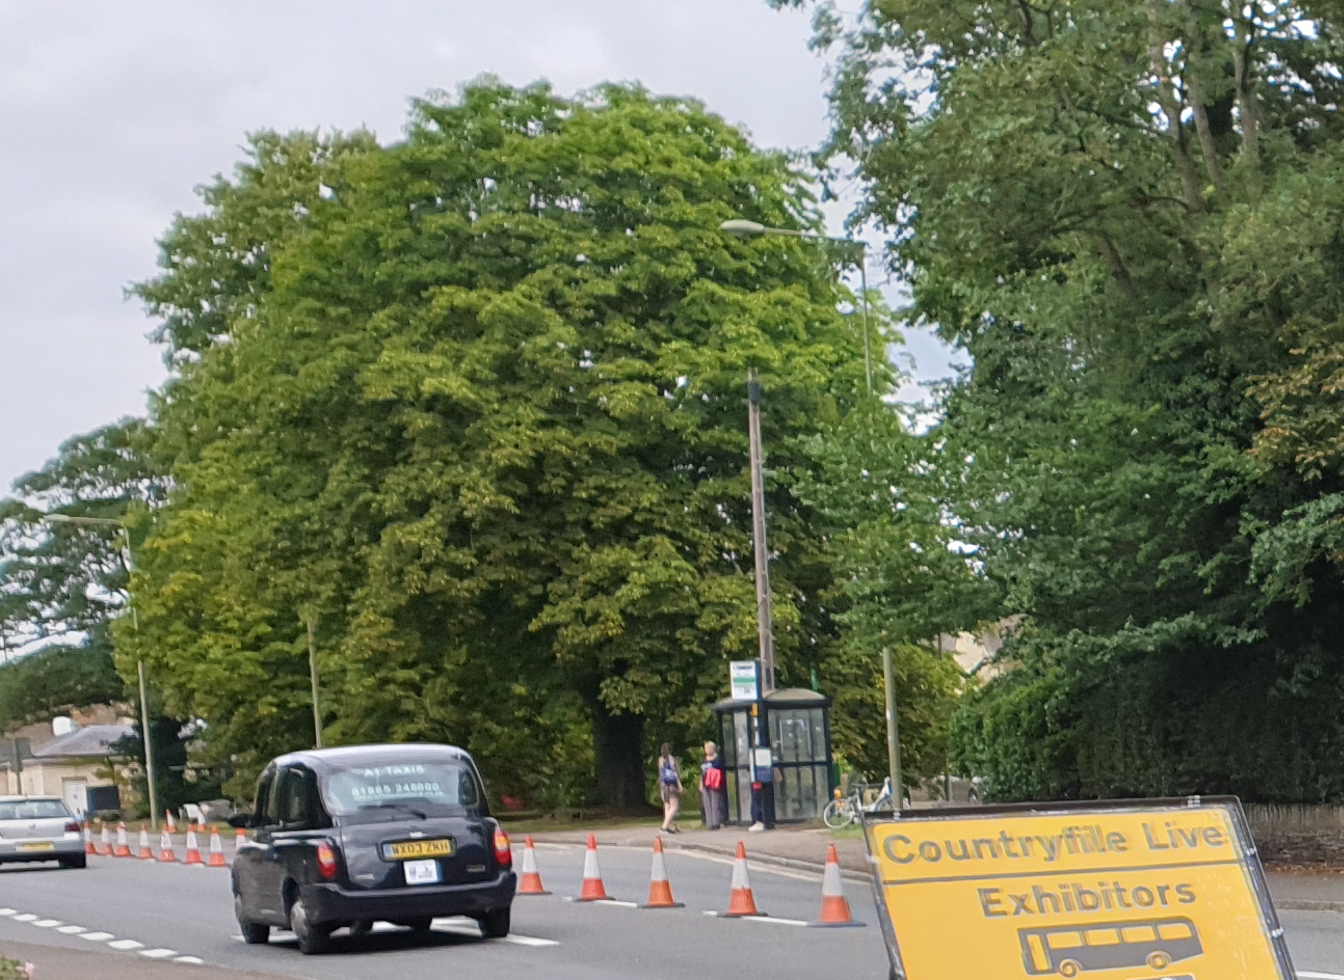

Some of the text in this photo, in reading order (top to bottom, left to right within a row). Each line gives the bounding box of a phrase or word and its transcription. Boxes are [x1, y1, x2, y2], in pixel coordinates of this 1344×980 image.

[385, 764, 425, 776] TAXIS
[882, 820, 1228, 865] Countryfile Live
[976, 881, 1197, 918] Exhibitors
